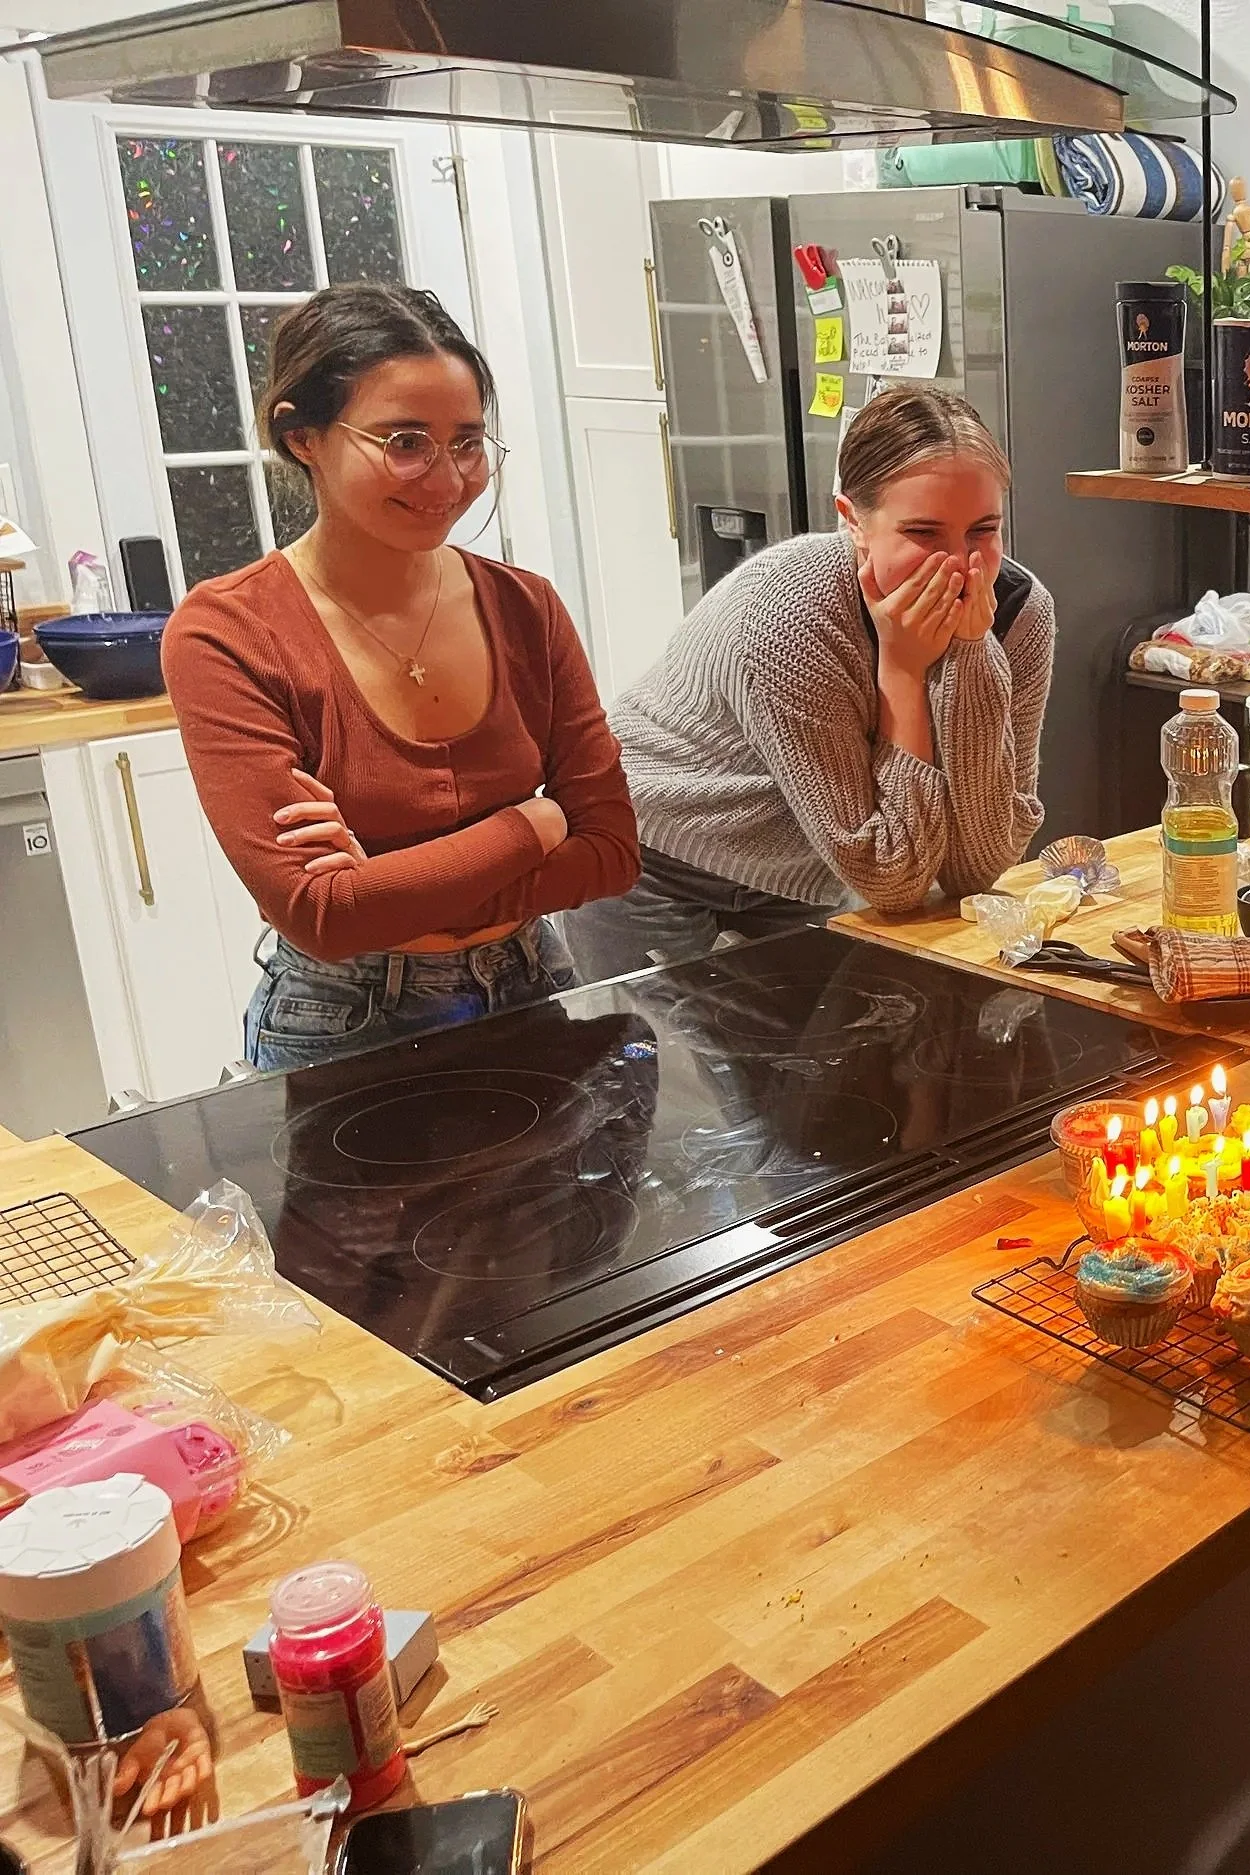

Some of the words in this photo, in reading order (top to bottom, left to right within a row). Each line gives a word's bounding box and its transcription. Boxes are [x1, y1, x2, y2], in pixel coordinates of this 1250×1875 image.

[1127, 341, 1169, 352] MORTON
[1126, 384, 1171, 395] KOSHER
[1131, 396, 1161, 407] SALT
